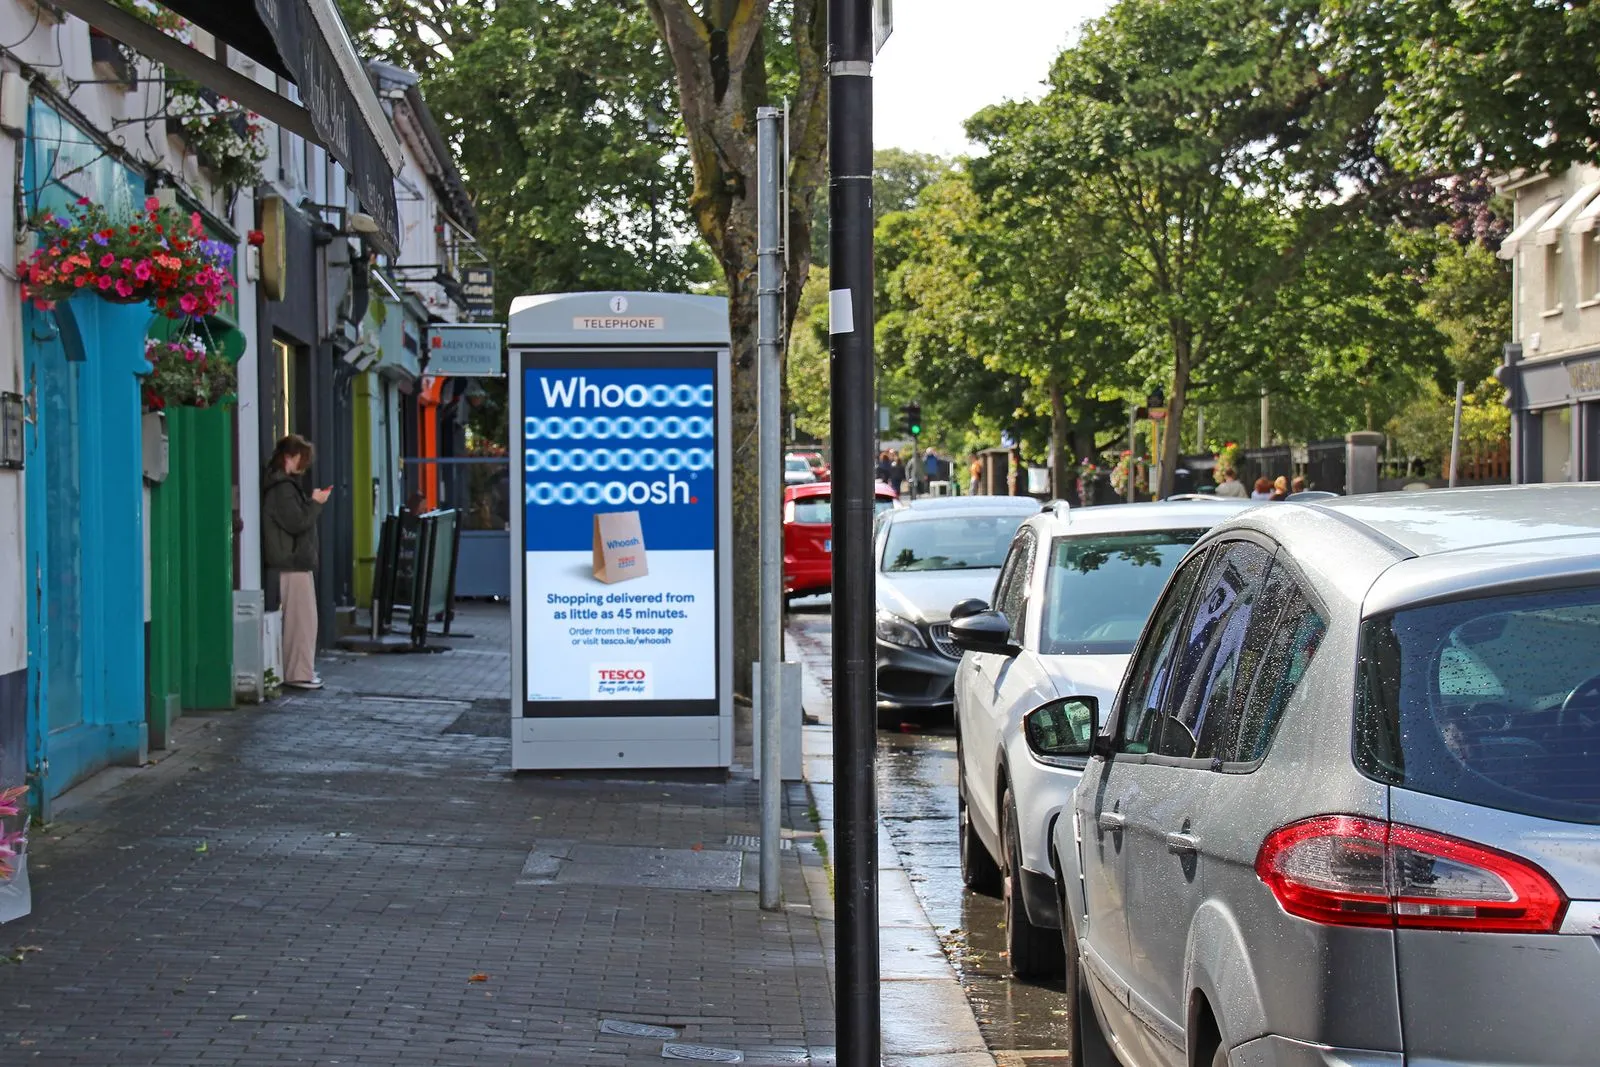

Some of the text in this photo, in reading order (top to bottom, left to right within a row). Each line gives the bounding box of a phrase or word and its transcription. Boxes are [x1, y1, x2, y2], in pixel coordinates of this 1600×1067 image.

[583, 319, 655, 328] TELEPHONE
[546, 592, 695, 606] Shopping delivered from
[553, 608, 688, 620] as little as 45 minutes.
[569, 627, 674, 637] Order from the Tesco app
[582, 637, 599, 645] visit
[600, 636, 671, 646] tesco.ie/whoosh
[598, 669, 646, 680] TESCO
